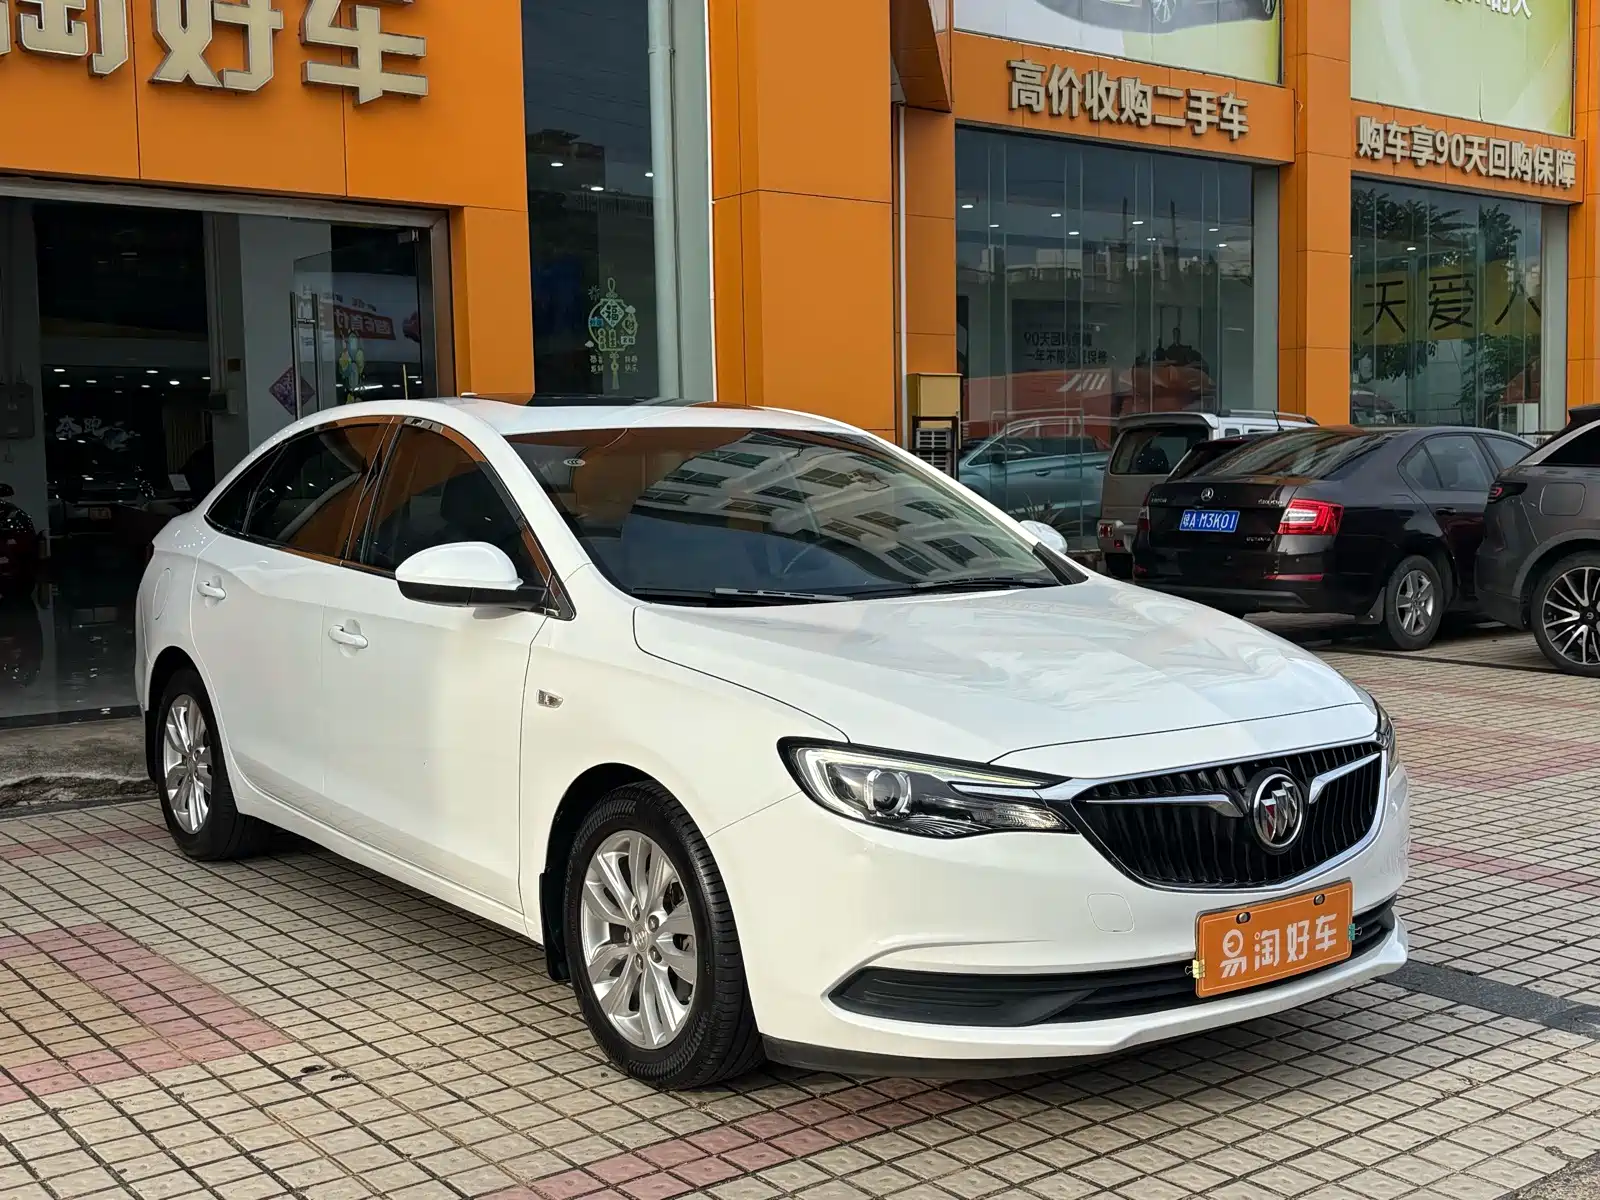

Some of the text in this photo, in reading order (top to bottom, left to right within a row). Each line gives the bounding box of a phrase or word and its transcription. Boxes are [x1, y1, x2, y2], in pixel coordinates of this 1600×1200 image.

[1007, 59, 1249, 141] 高价收购二手车
[1357, 116, 1576, 188] 购车享90天回购保障
